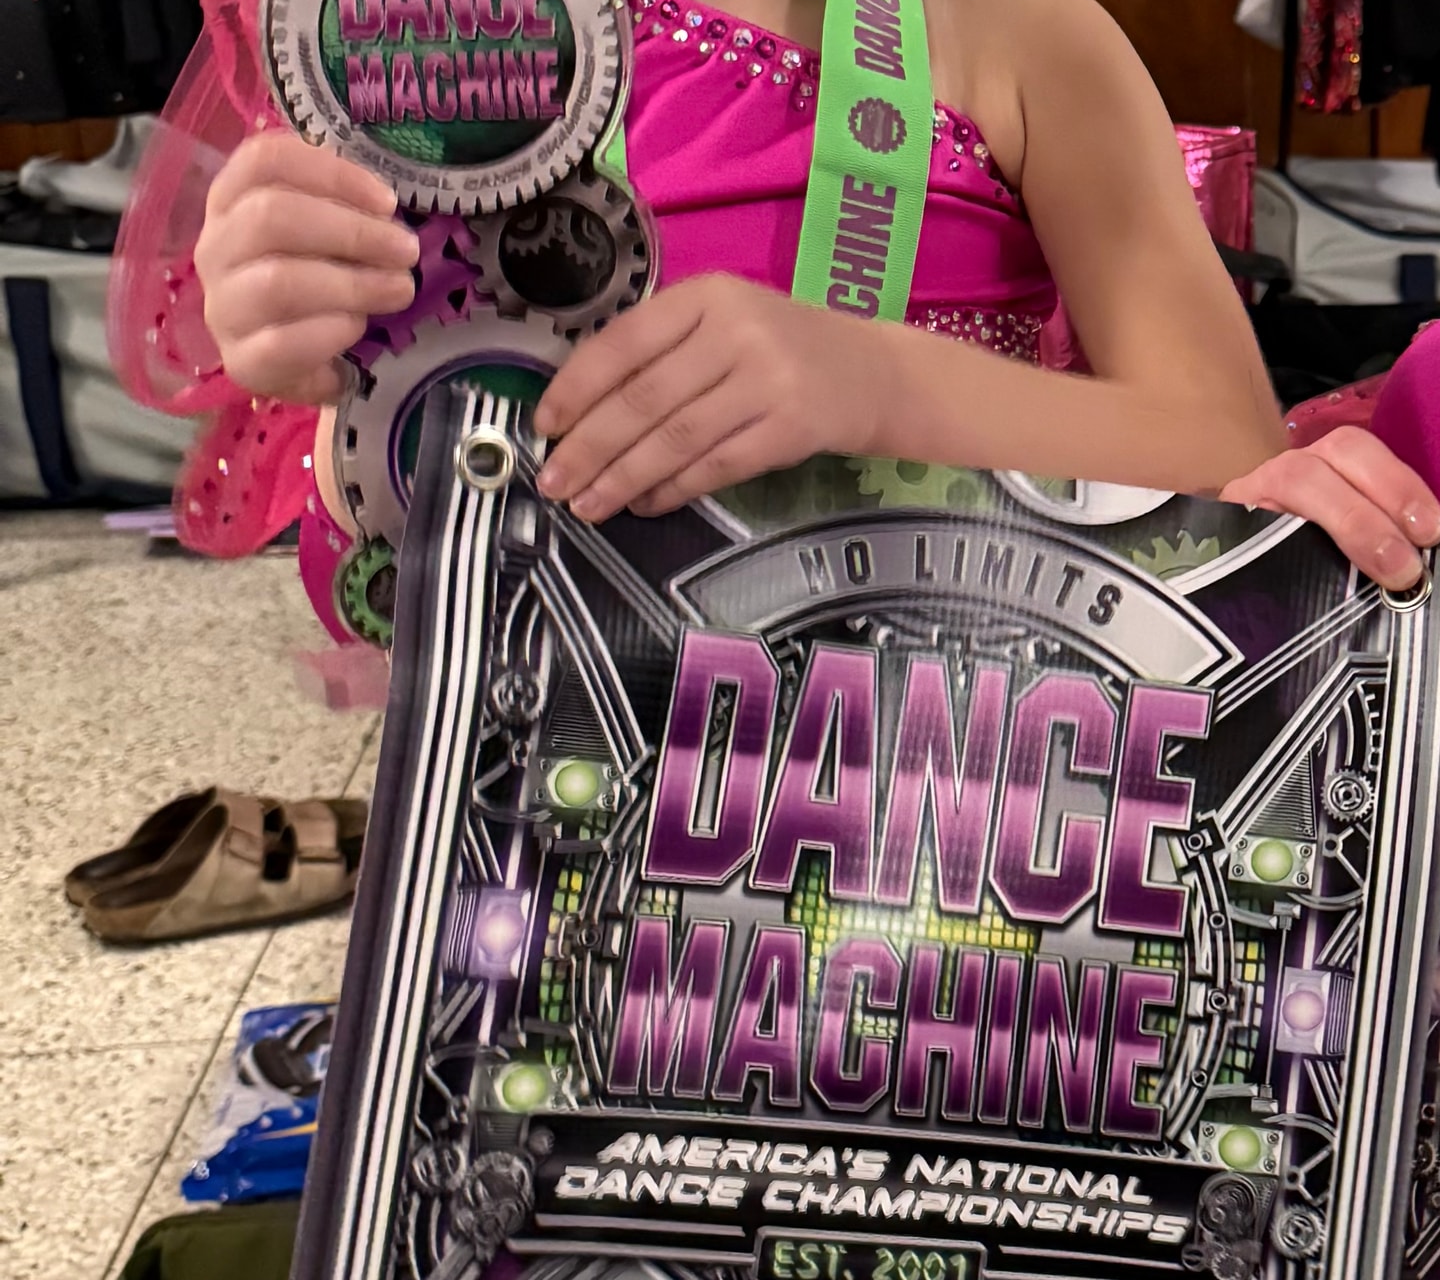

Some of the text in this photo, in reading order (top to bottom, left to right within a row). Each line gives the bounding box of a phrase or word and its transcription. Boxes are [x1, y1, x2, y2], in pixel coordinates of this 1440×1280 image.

[345, 49, 565, 124] MACHINE
[826, 174, 896, 319] CHINE
[799, 532, 1123, 626] NO LIMITS
[641, 624, 1216, 938] DANCE
[606, 913, 1183, 1143] MACHINE
[555, 1165, 1192, 1245] DANCE CHAMPIONSHIPS
[597, 1131, 1152, 1206] AMERICA'S NATIONAL
